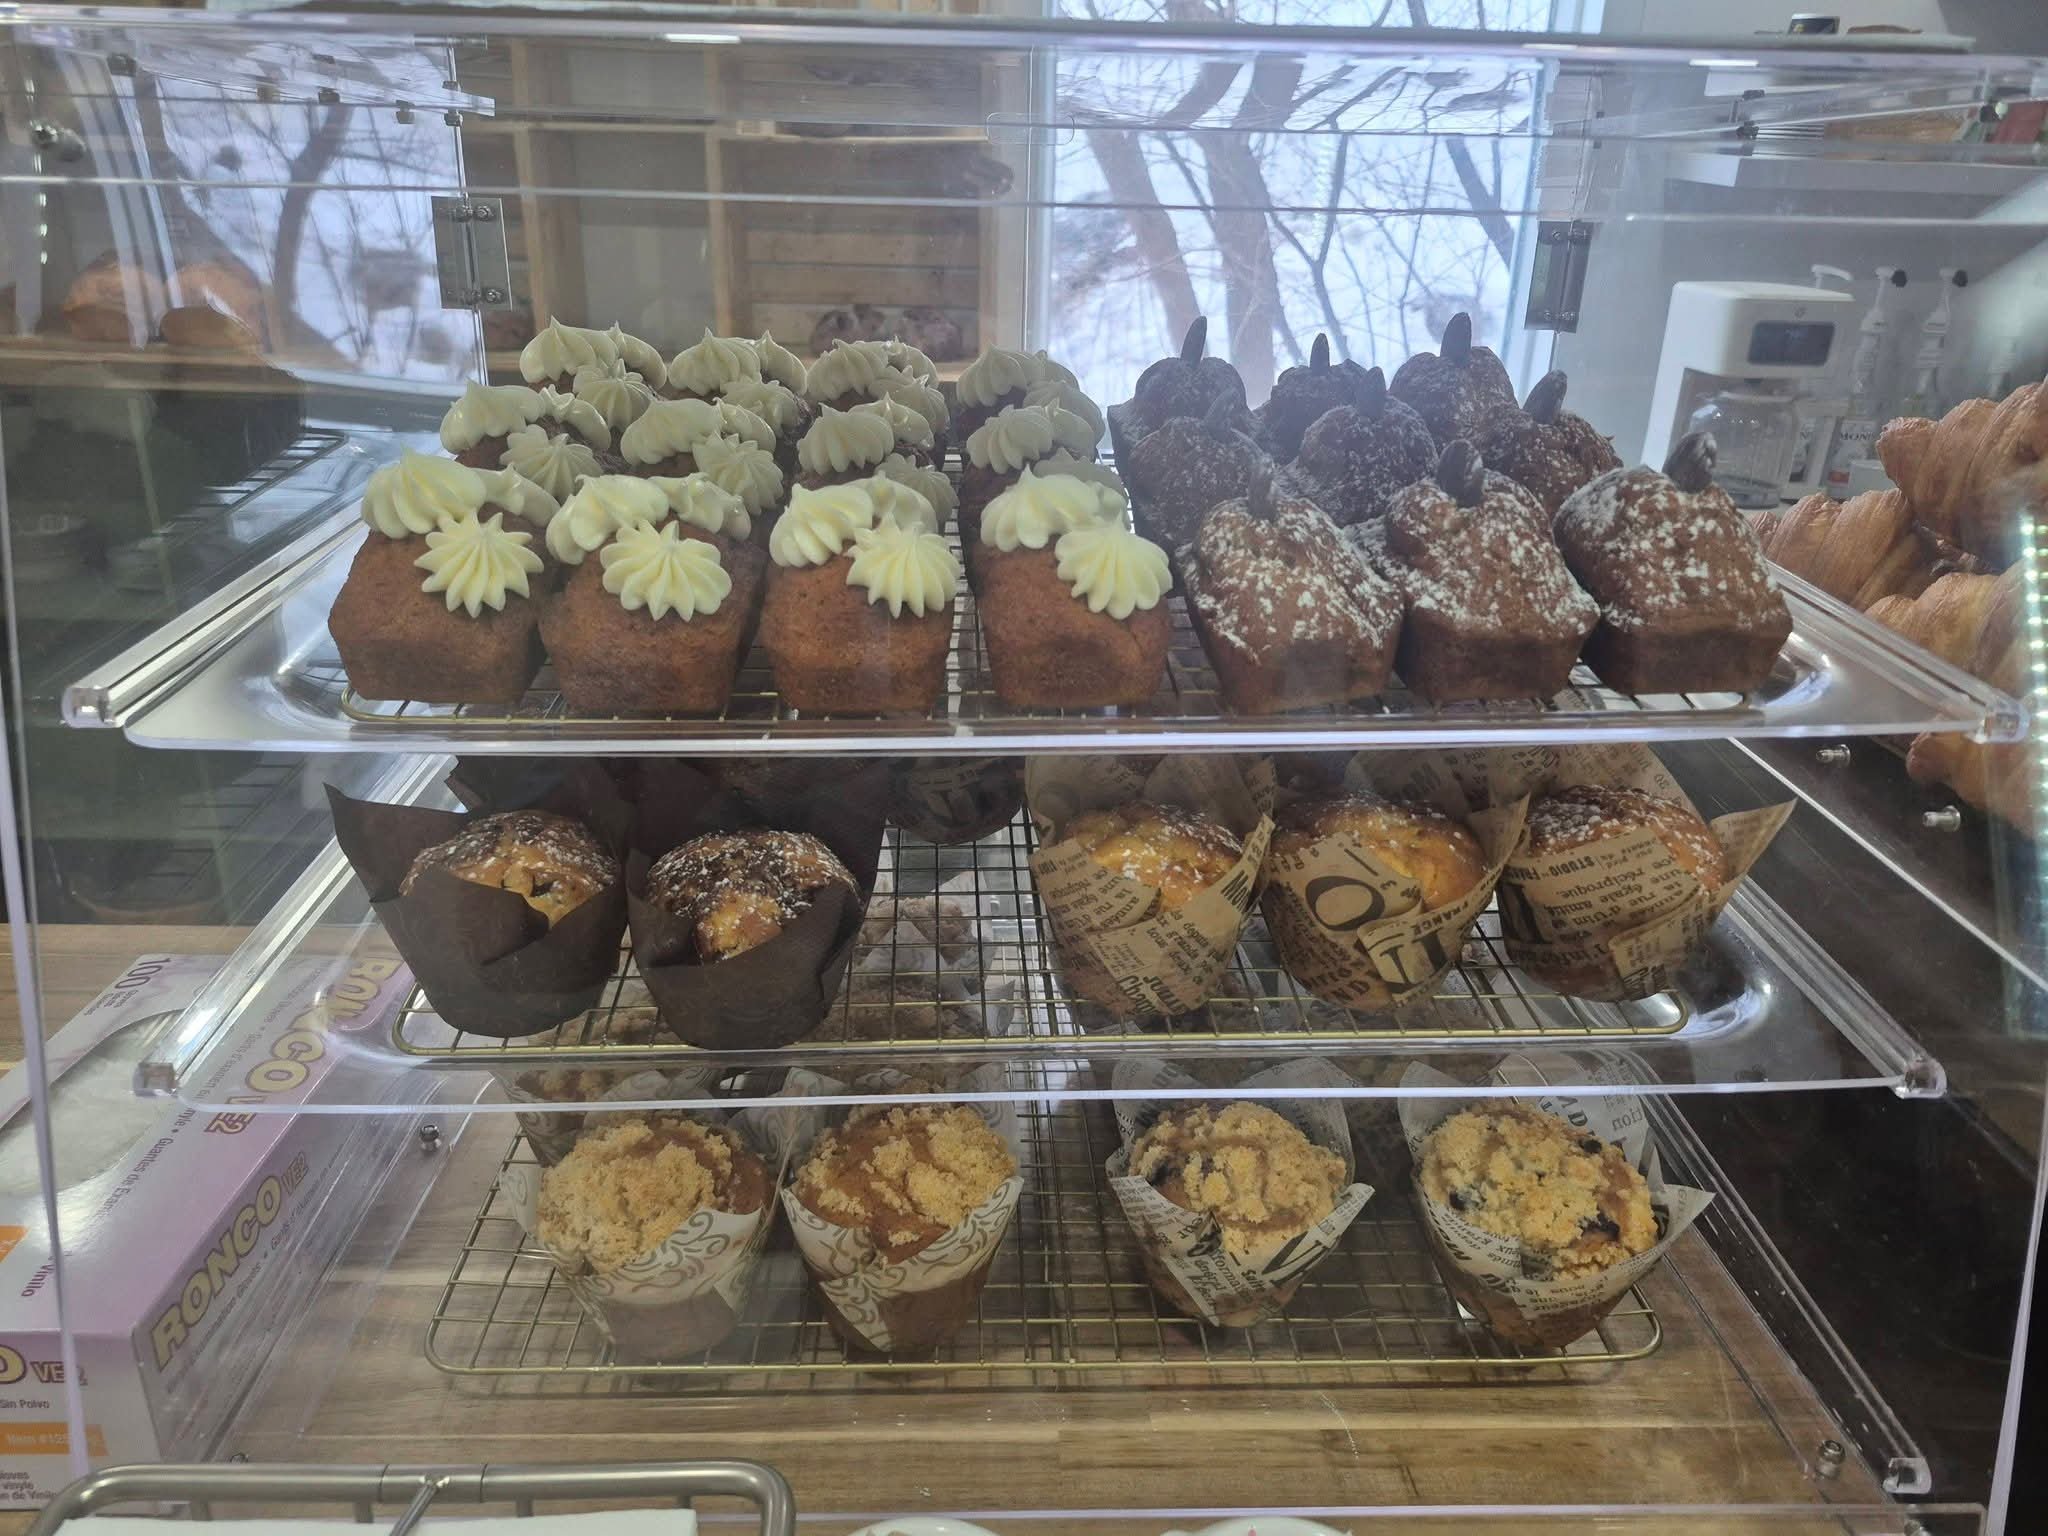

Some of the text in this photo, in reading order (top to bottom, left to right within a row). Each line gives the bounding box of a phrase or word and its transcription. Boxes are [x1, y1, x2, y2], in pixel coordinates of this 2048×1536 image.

[121, 956, 172, 990] 100
[245, 956, 402, 1095] RONCO
[153, 1170, 288, 1370] RONCO
